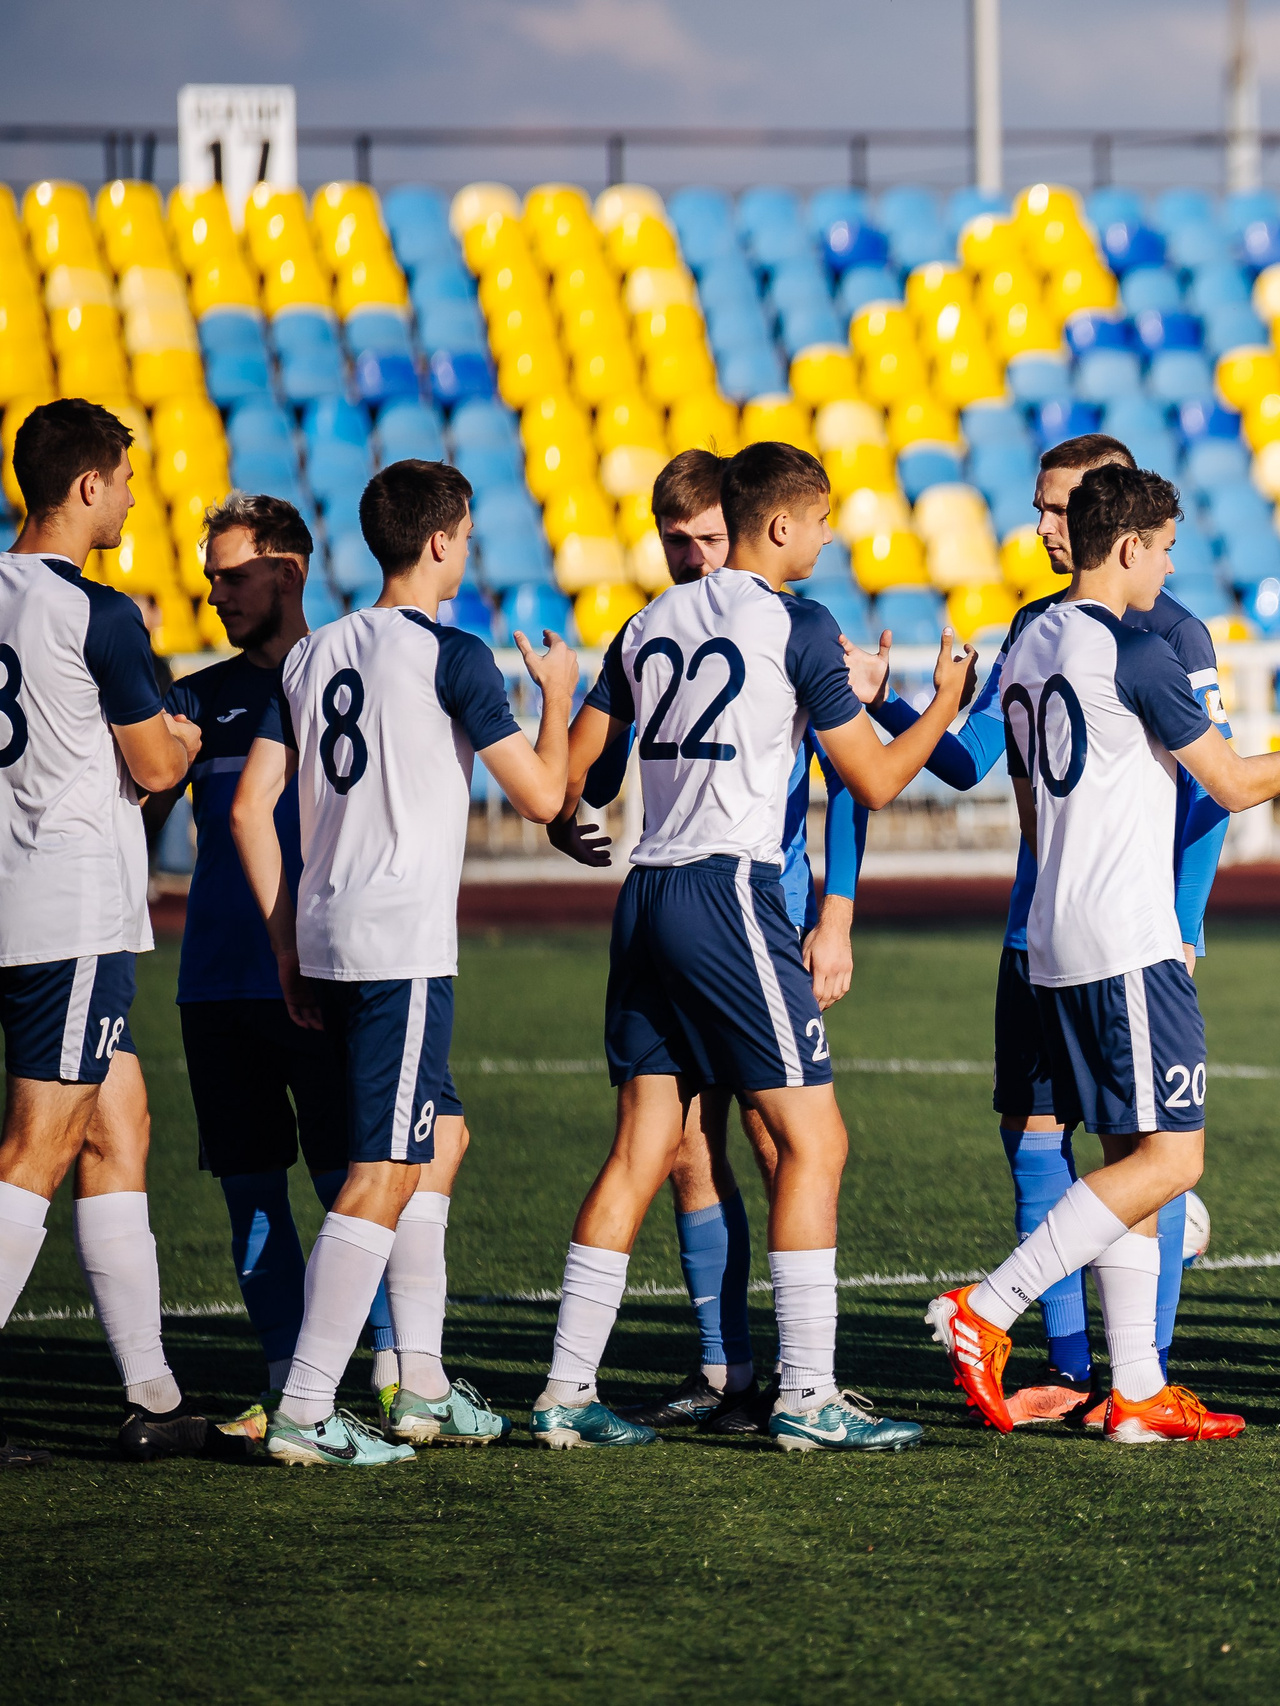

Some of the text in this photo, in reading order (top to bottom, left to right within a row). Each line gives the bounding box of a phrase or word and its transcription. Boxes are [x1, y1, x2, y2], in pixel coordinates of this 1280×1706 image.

[633, 637, 745, 761] 22
[320, 668, 368, 795] 8
[95, 1016, 124, 1059] 18
[1165, 1062, 1206, 1107] 20
[413, 1100, 434, 1142] 8
